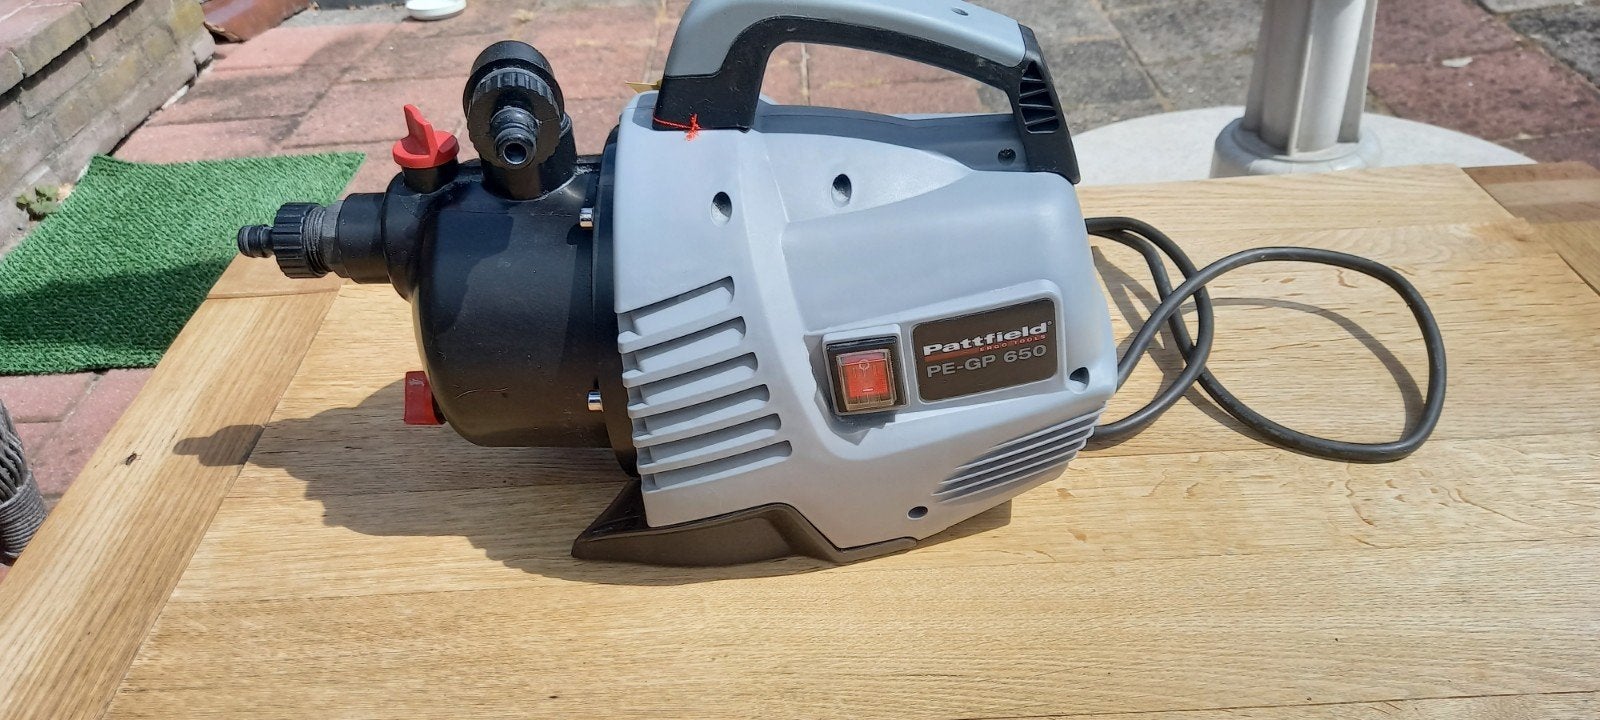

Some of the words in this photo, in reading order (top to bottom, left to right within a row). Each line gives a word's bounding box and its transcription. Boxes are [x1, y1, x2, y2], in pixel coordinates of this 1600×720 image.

[923, 322, 1047, 356] Pattfield
[980, 342, 1008, 352] ERGO
[1014, 334, 1047, 345] TOOLS
[927, 355, 996, 378] PE-GP
[1003, 344, 1047, 363] 650
